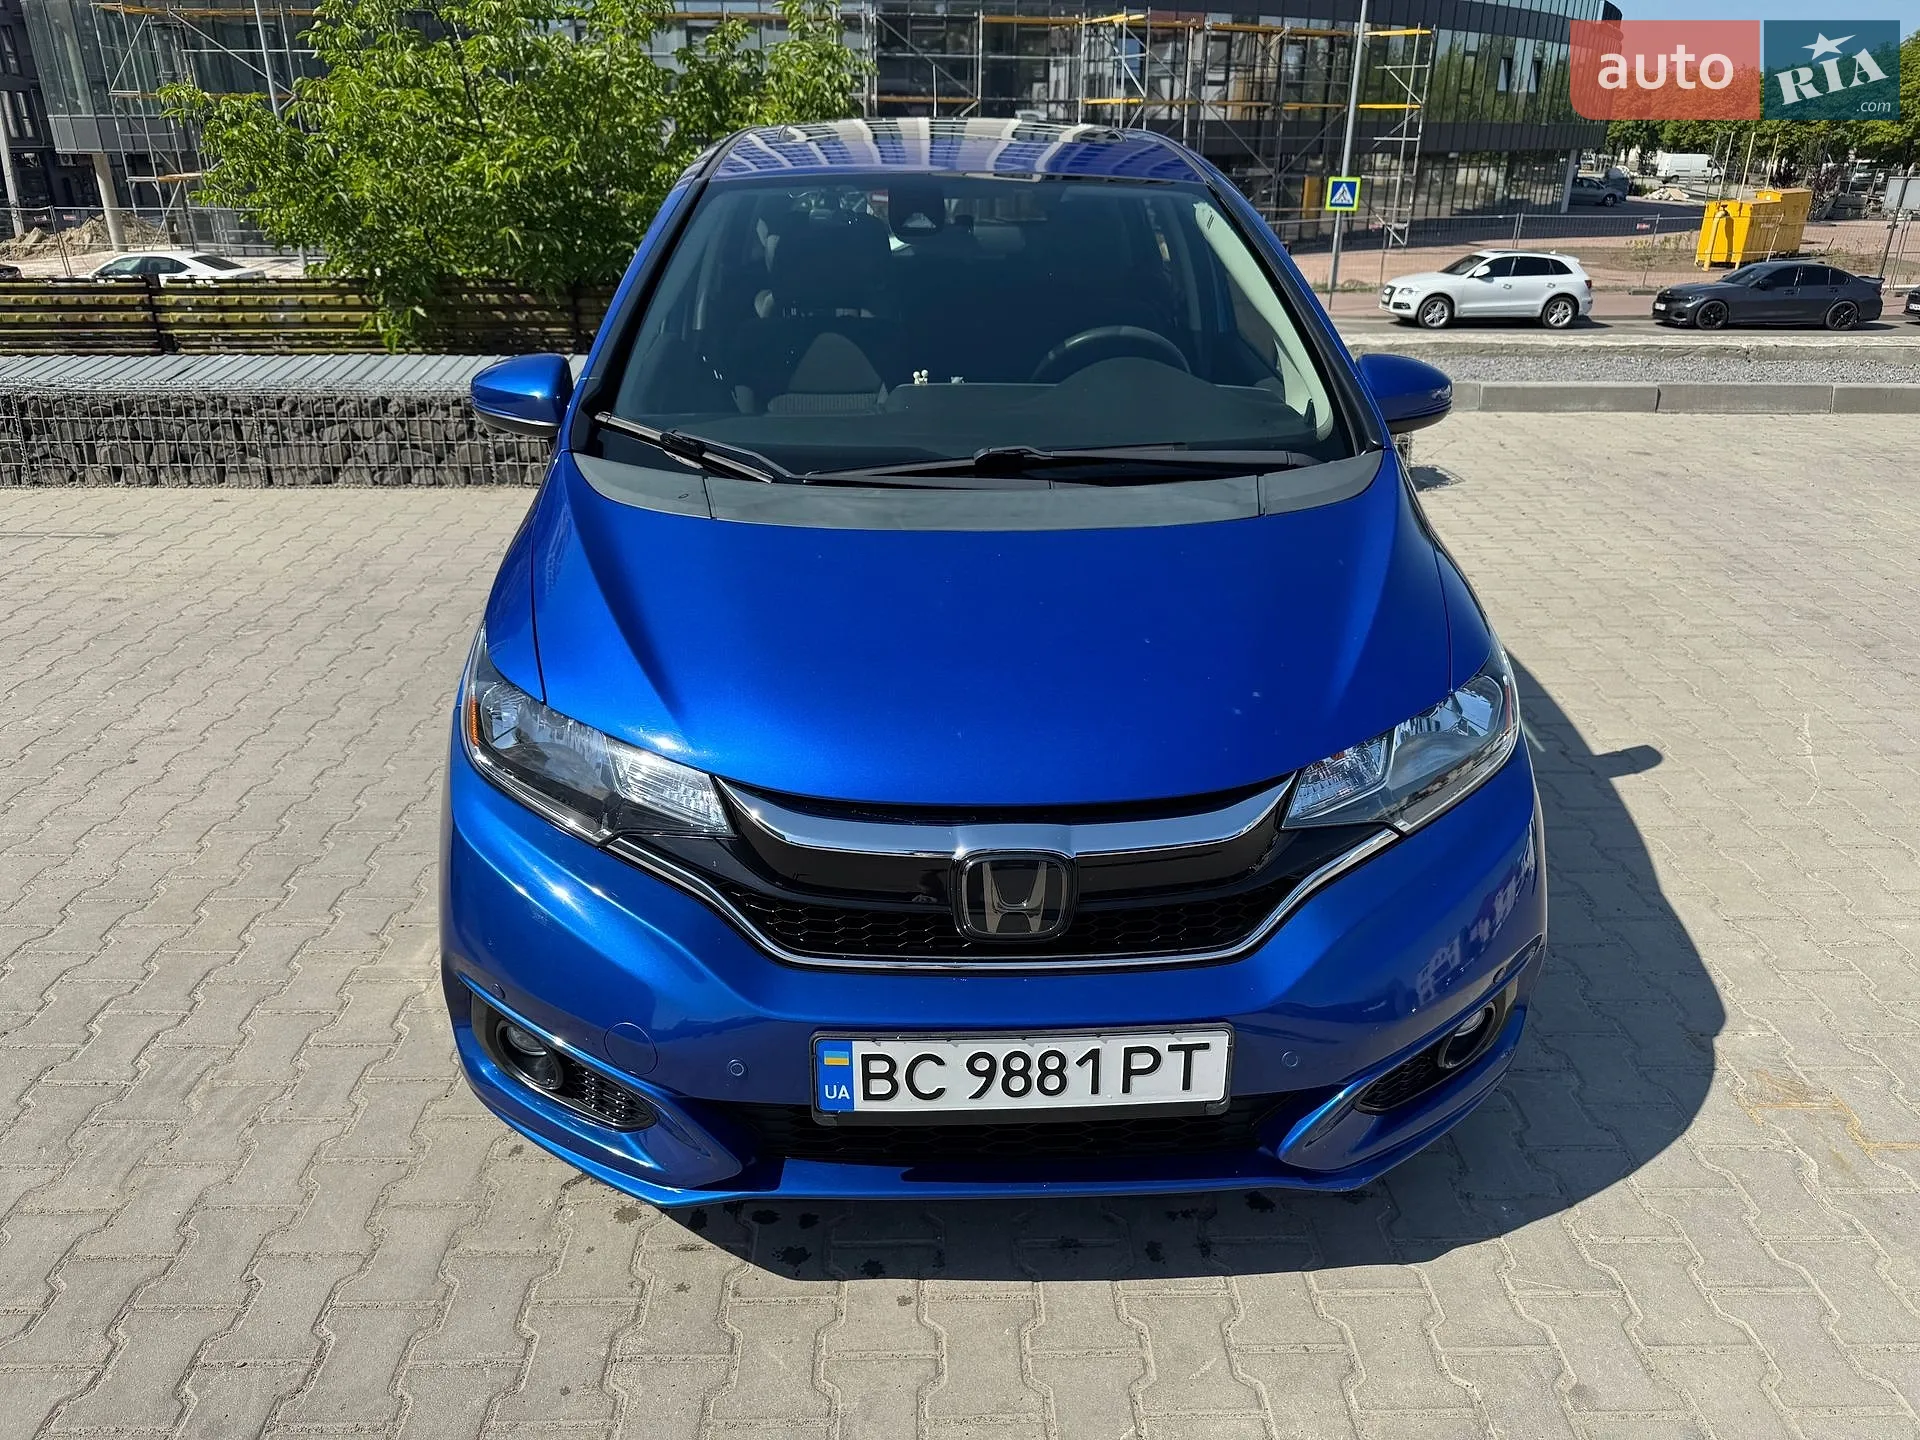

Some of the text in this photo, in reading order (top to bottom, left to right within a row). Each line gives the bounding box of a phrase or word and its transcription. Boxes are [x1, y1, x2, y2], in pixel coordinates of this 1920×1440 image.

[860, 1042, 1210, 1102] BC 9881 PT
[824, 1084, 851, 1100] UA
